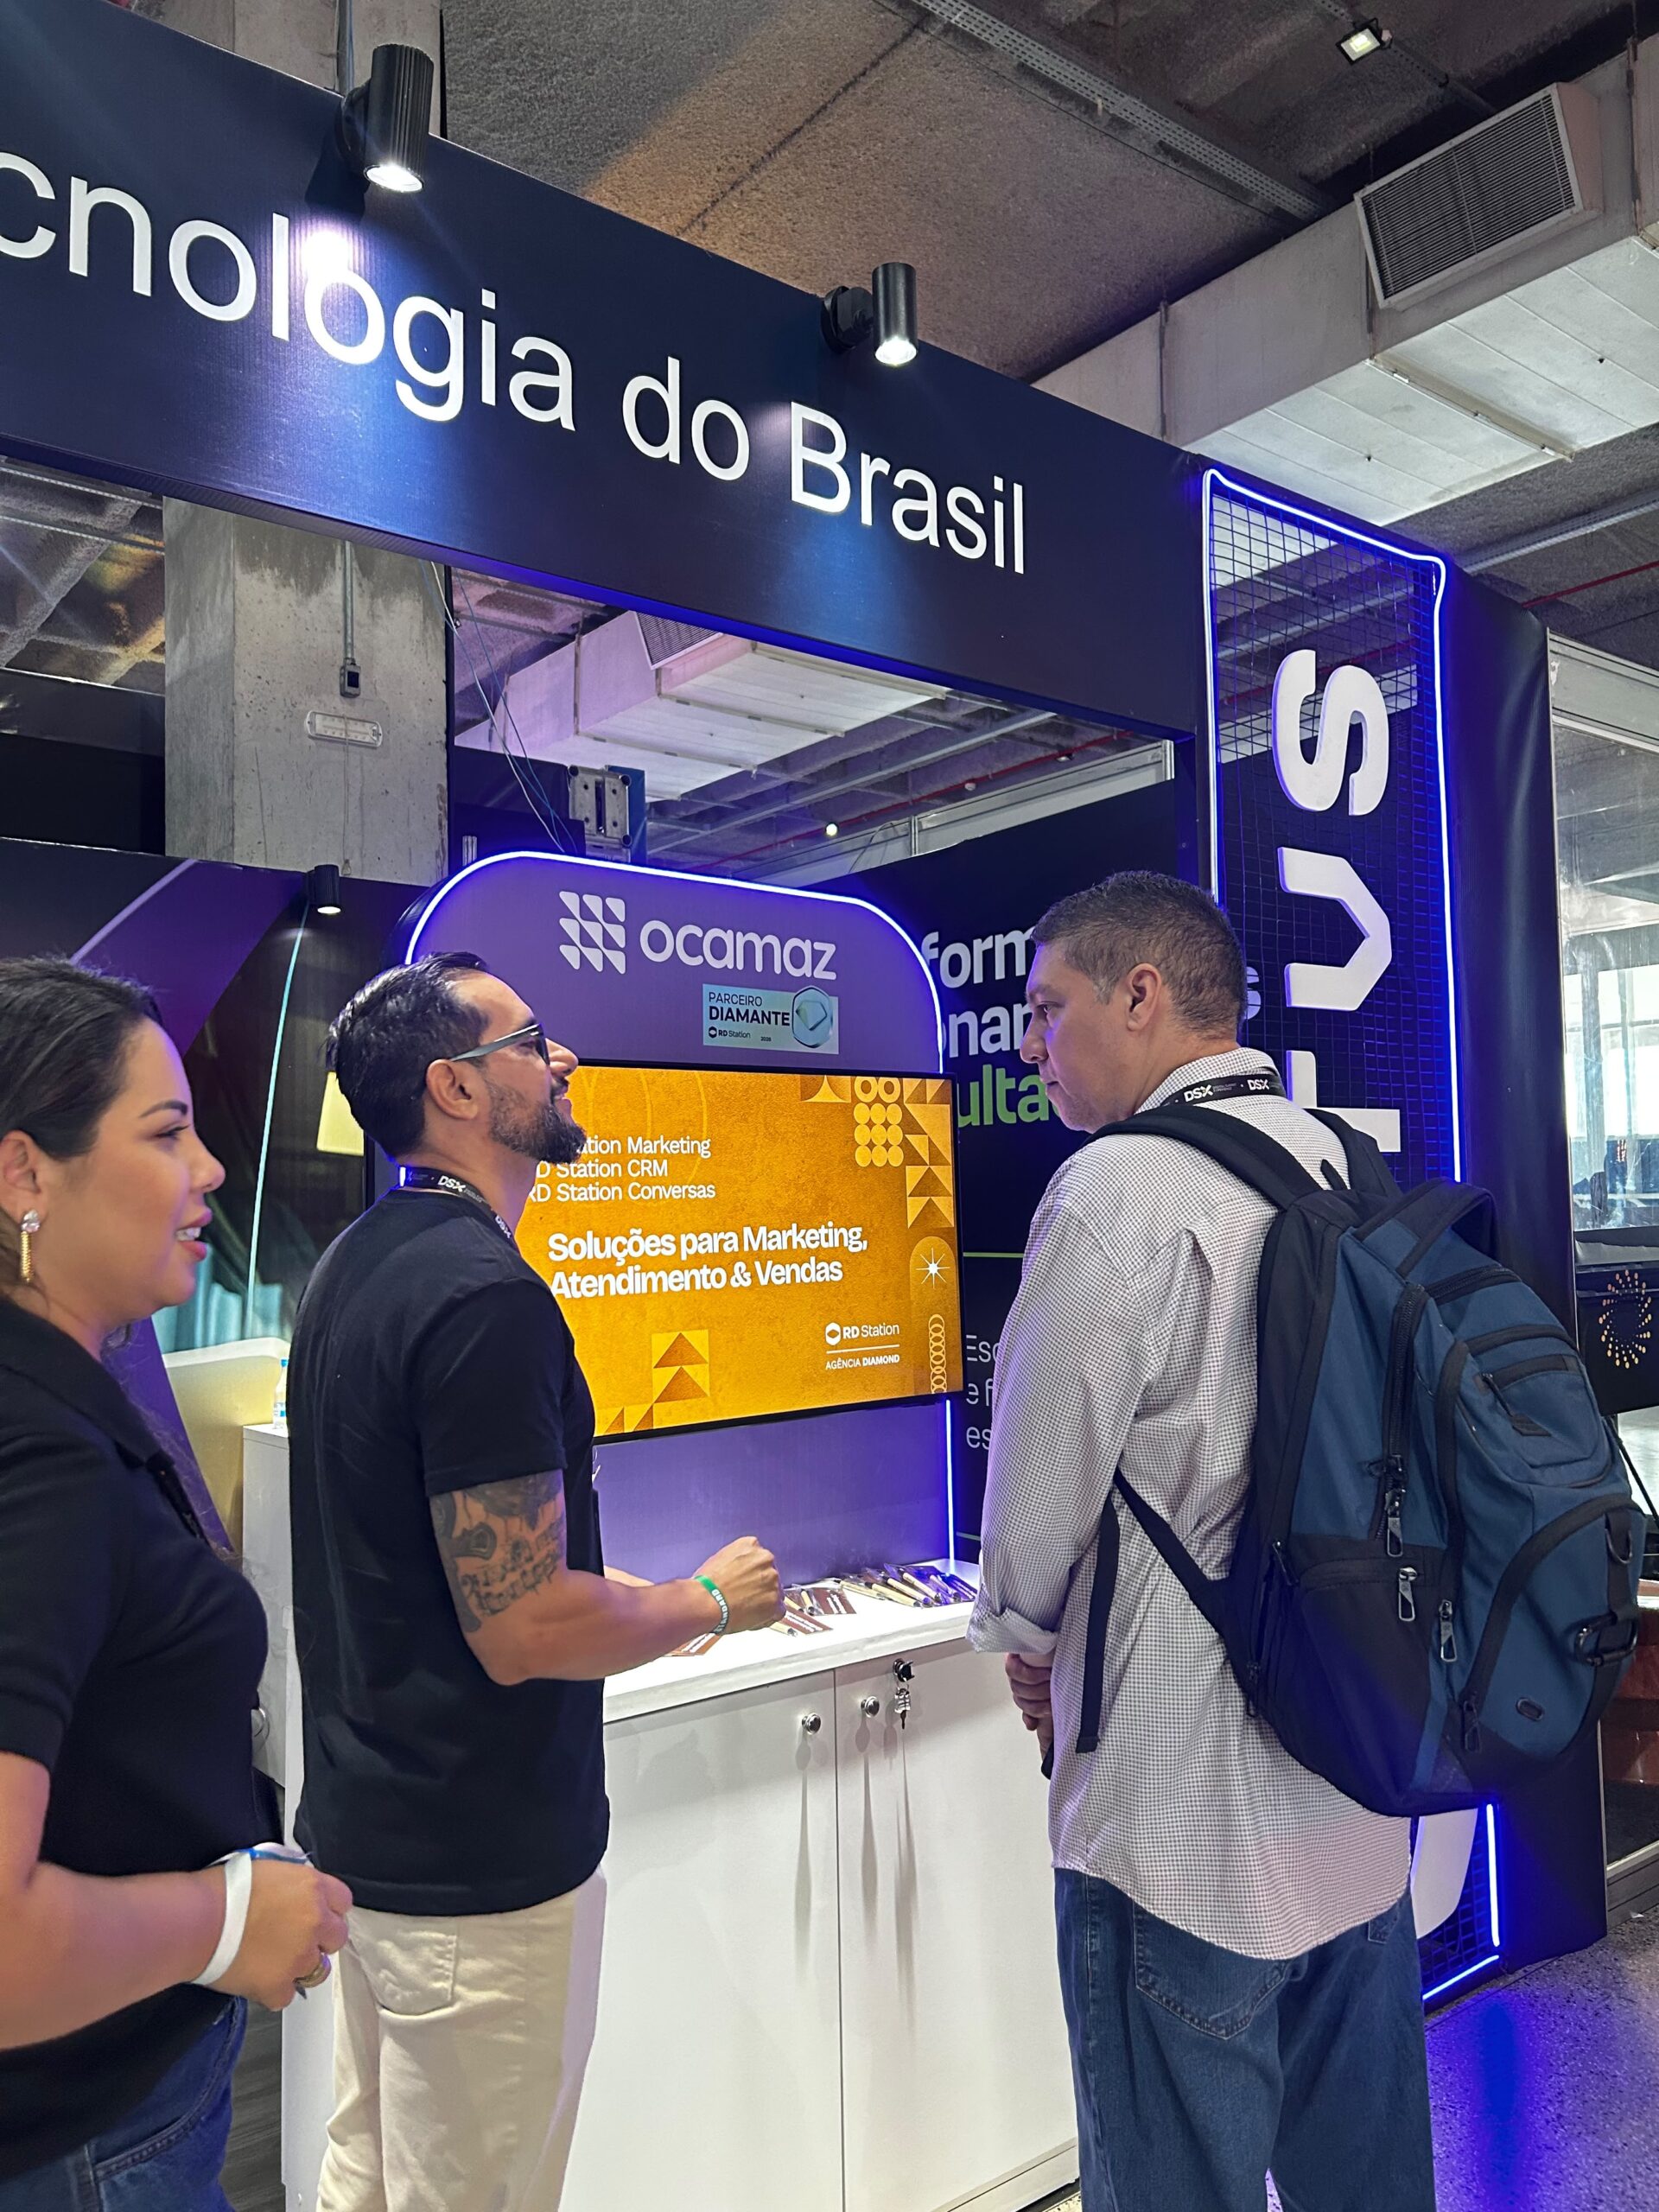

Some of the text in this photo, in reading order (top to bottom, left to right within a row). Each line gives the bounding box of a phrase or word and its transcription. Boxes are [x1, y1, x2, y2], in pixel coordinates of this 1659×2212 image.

[621, 356, 750, 481] do
[790, 400, 1024, 575] Brasil
[639, 919, 837, 981] ocamaz
[709, 991, 763, 1007] PARCEIRO
[709, 1006, 791, 1027] DIAMANTE
[728, 1030, 751, 1039] Station
[1183, 1084, 1214, 1103] DSX
[576, 1135, 712, 1159] ation Marketing
[556, 1159, 622, 1179] Station
[627, 1159, 668, 1178] CRM
[437, 1175, 467, 1192] DSX
[556, 1181, 623, 1202] Station
[627, 1182, 716, 1200] Conversas
[548, 1221, 868, 1267] Soluções para Marketing,
[550, 1256, 844, 1299] Atendimento & Vendas
[842, 1322, 899, 1339] RD Station
[825, 1353, 900, 1370] AGÊNCIA DIAMOND
